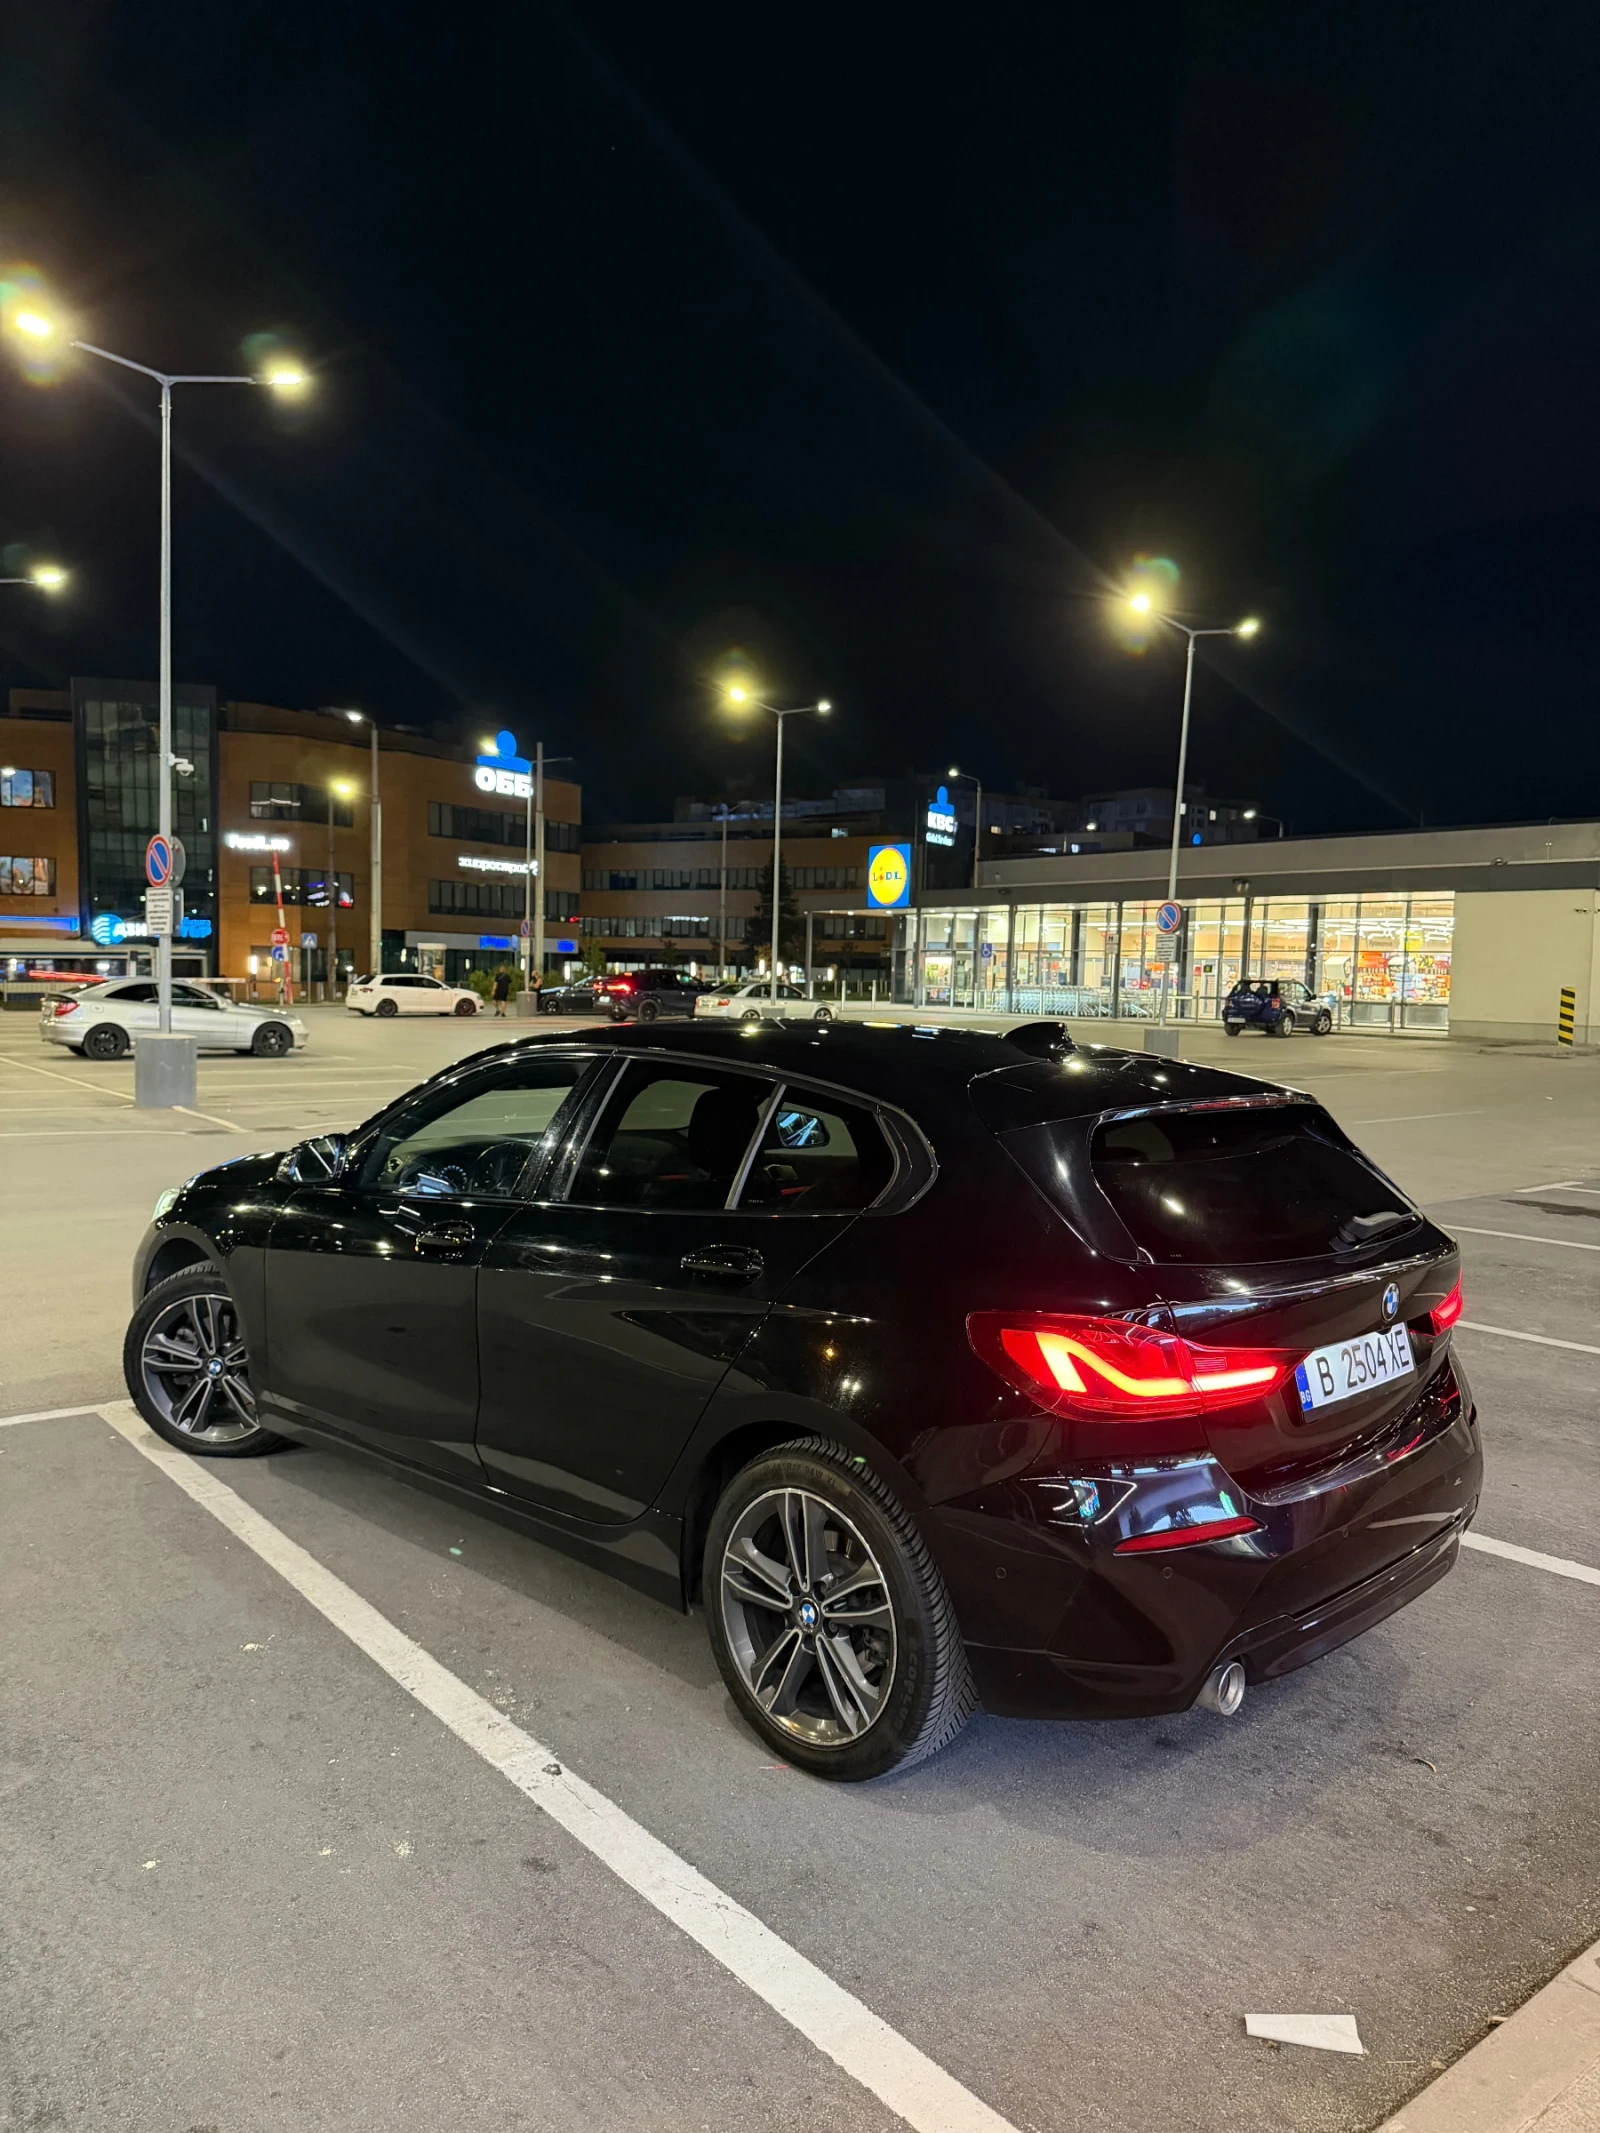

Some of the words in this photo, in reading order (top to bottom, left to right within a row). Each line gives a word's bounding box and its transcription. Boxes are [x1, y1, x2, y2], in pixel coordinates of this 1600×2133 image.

[928, 811, 953, 832] KBC
[1315, 1356, 1335, 1397] B
[1300, 1389, 1312, 1404] BG
